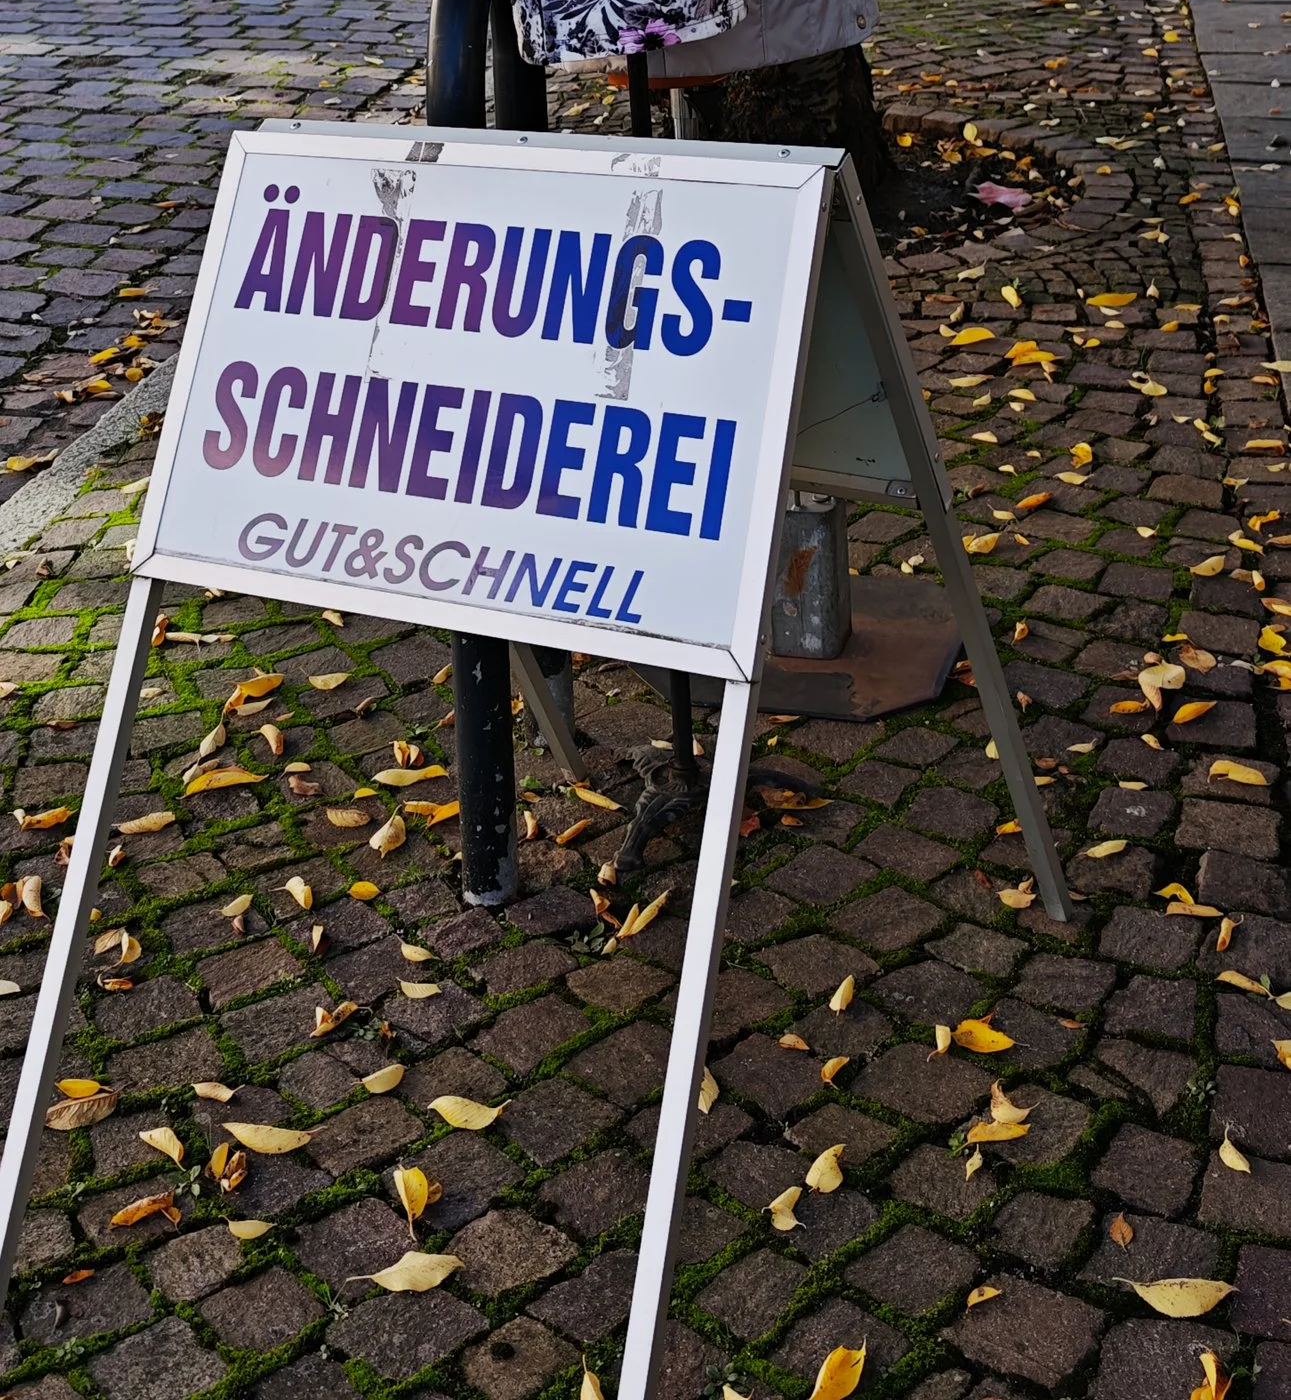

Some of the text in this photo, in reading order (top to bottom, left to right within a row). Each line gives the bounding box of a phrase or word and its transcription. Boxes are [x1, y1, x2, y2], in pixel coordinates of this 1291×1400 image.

[234, 184, 753, 357] ÄNDERUNGS-
[202, 360, 738, 541] SCHNEIDEREI
[237, 512, 645, 624] GUT&SCHNELL
